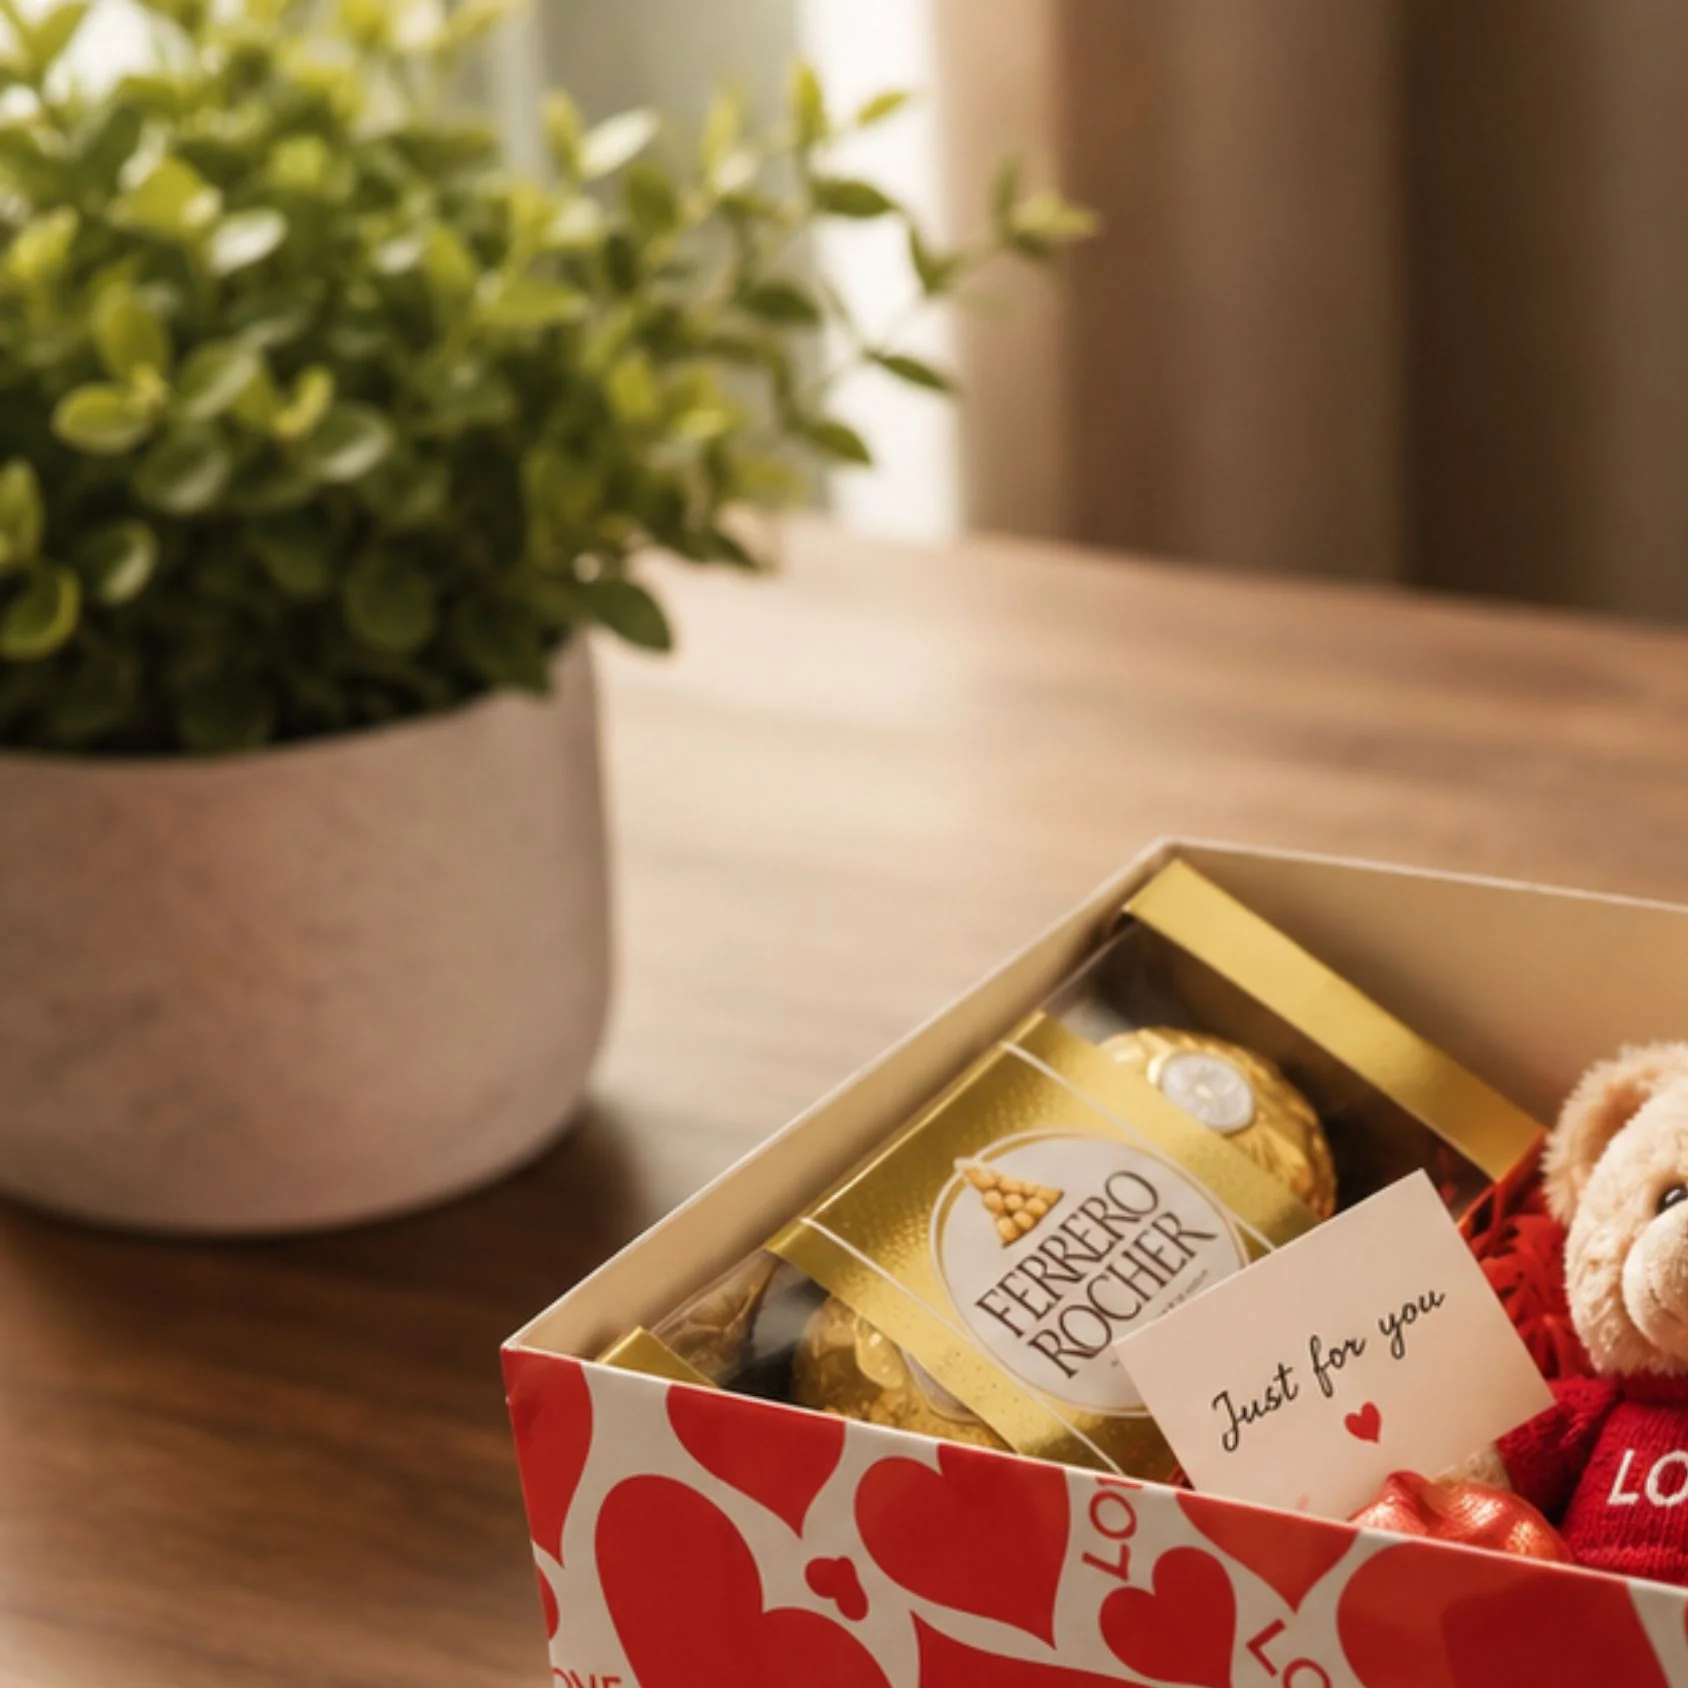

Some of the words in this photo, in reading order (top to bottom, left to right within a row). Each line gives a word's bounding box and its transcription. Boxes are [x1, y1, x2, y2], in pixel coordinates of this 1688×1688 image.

[975, 1170, 1158, 1338] FERRERO
[1027, 1211, 1219, 1379] ROCHER
[1211, 1362, 1298, 1452] Just
[1310, 1334, 1366, 1398] for
[1378, 1290, 1446, 1360] you
